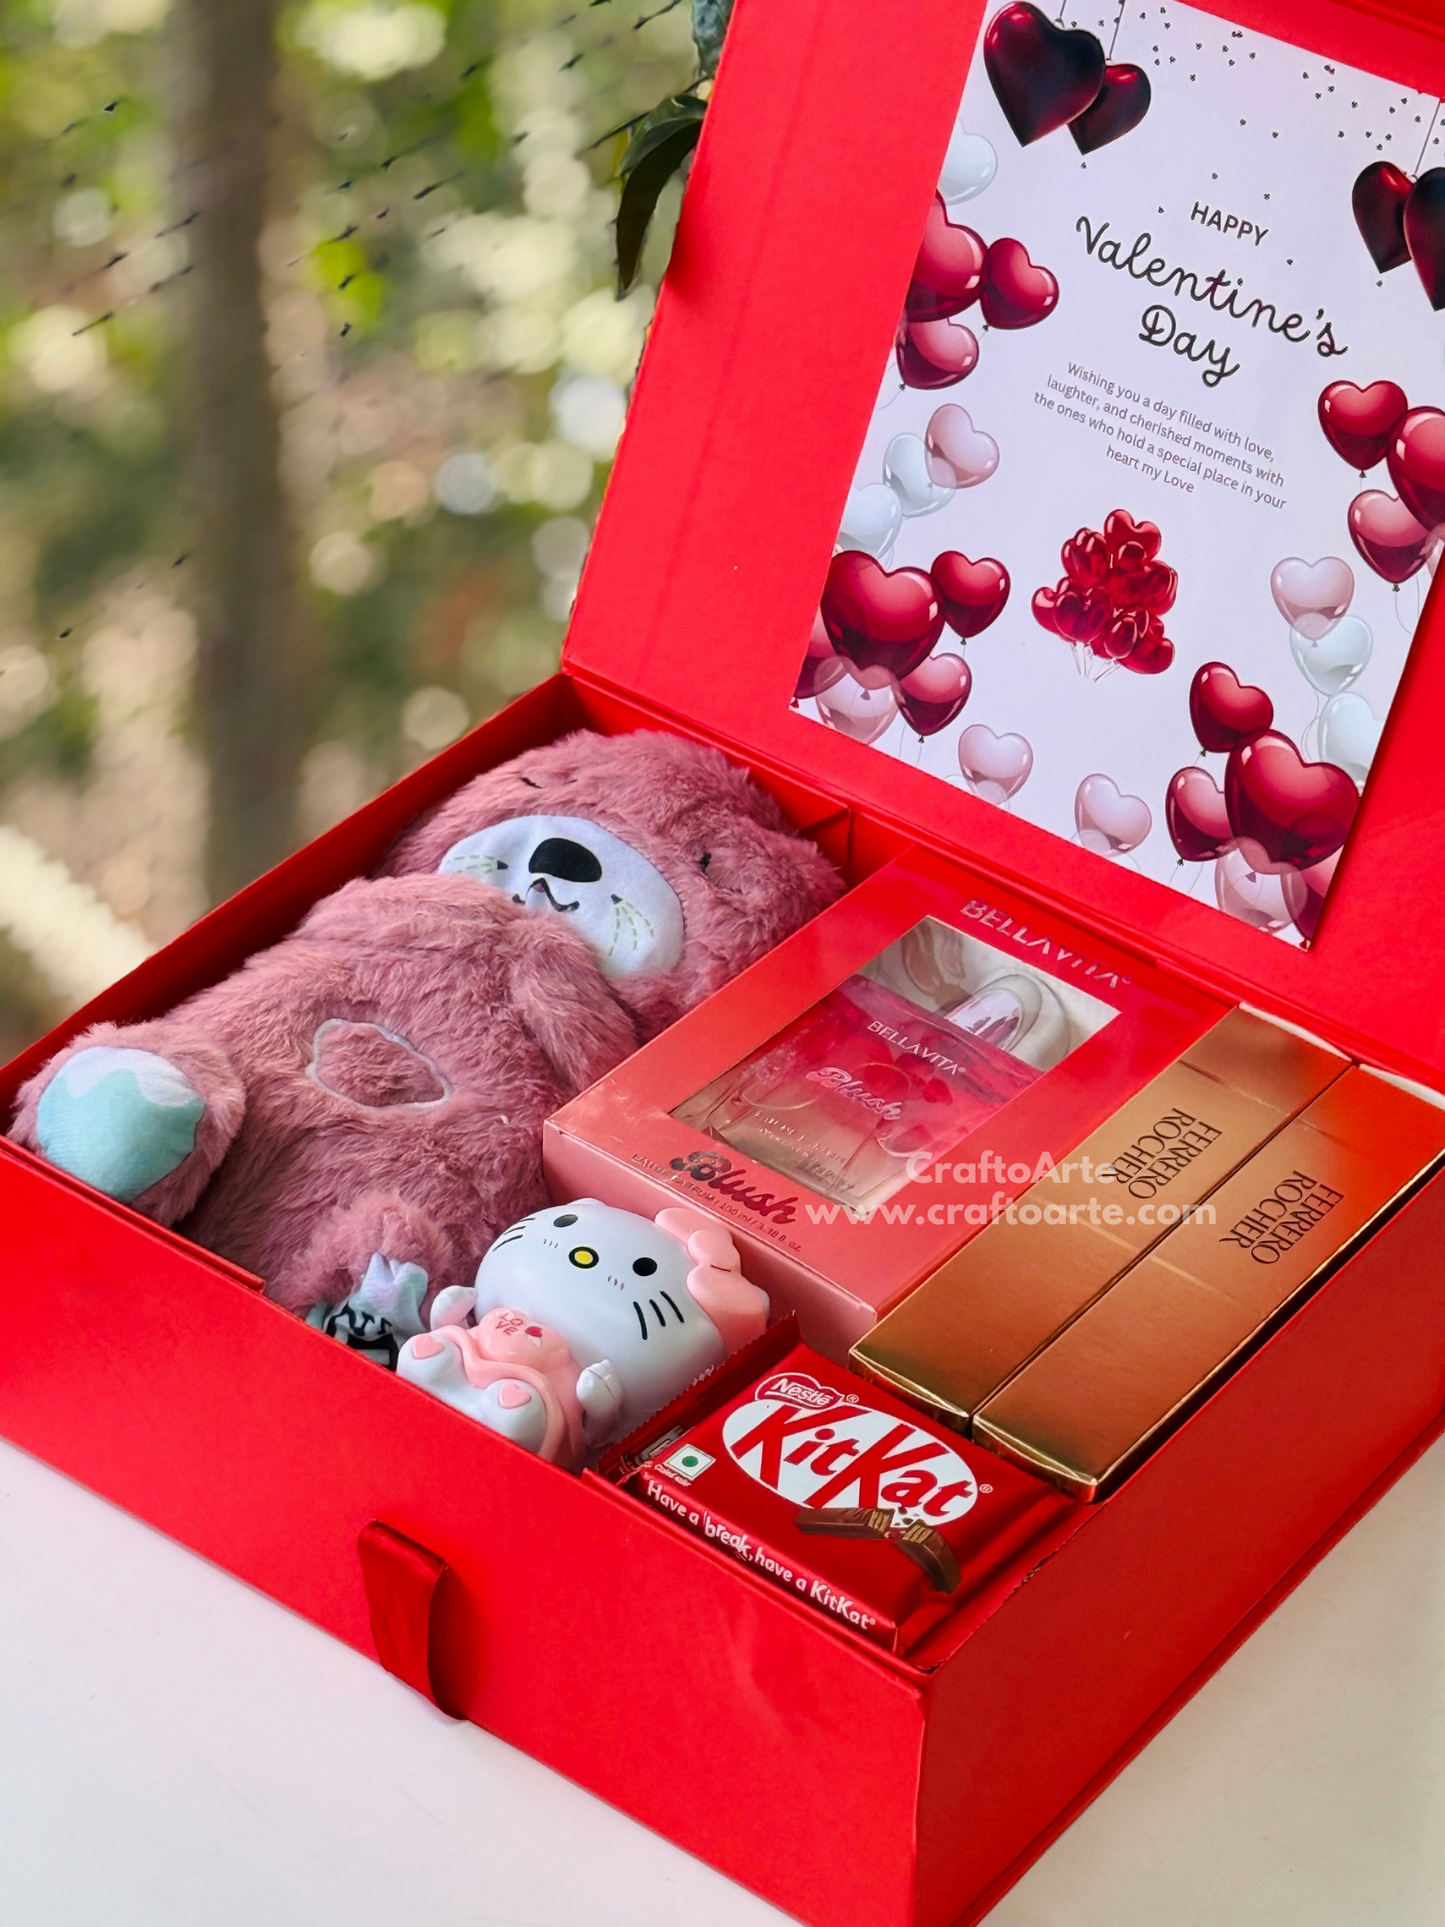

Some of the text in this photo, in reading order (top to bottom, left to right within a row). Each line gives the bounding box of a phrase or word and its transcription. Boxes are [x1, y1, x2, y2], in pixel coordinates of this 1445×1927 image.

[1191, 202, 1269, 246] HAPPY
[1076, 216, 1348, 357] Valentine's
[1138, 305, 1240, 387] Day
[1034, 392, 1287, 509] the ones who hold a special place in your
[1047, 374, 1284, 487] laughter, and cherished moments with
[1068, 362, 1274, 462] Wishing you a day filled with love,
[1106, 445, 1194, 493] heart my Love
[805, 1066, 902, 1120] Blush
[1097, 1107, 1196, 1185] ROCHER
[1128, 1121, 1223, 1199] FERRERO
[669, 1150, 799, 1225] Blush
[1219, 1170, 1318, 1249] ROCHER
[1250, 1184, 1345, 1265] FERRERO
[647, 1480, 687, 1517] Have
[688, 1512, 700, 1525] a
[755, 1546, 793, 1582] have
[795, 1577, 807, 1592] a
